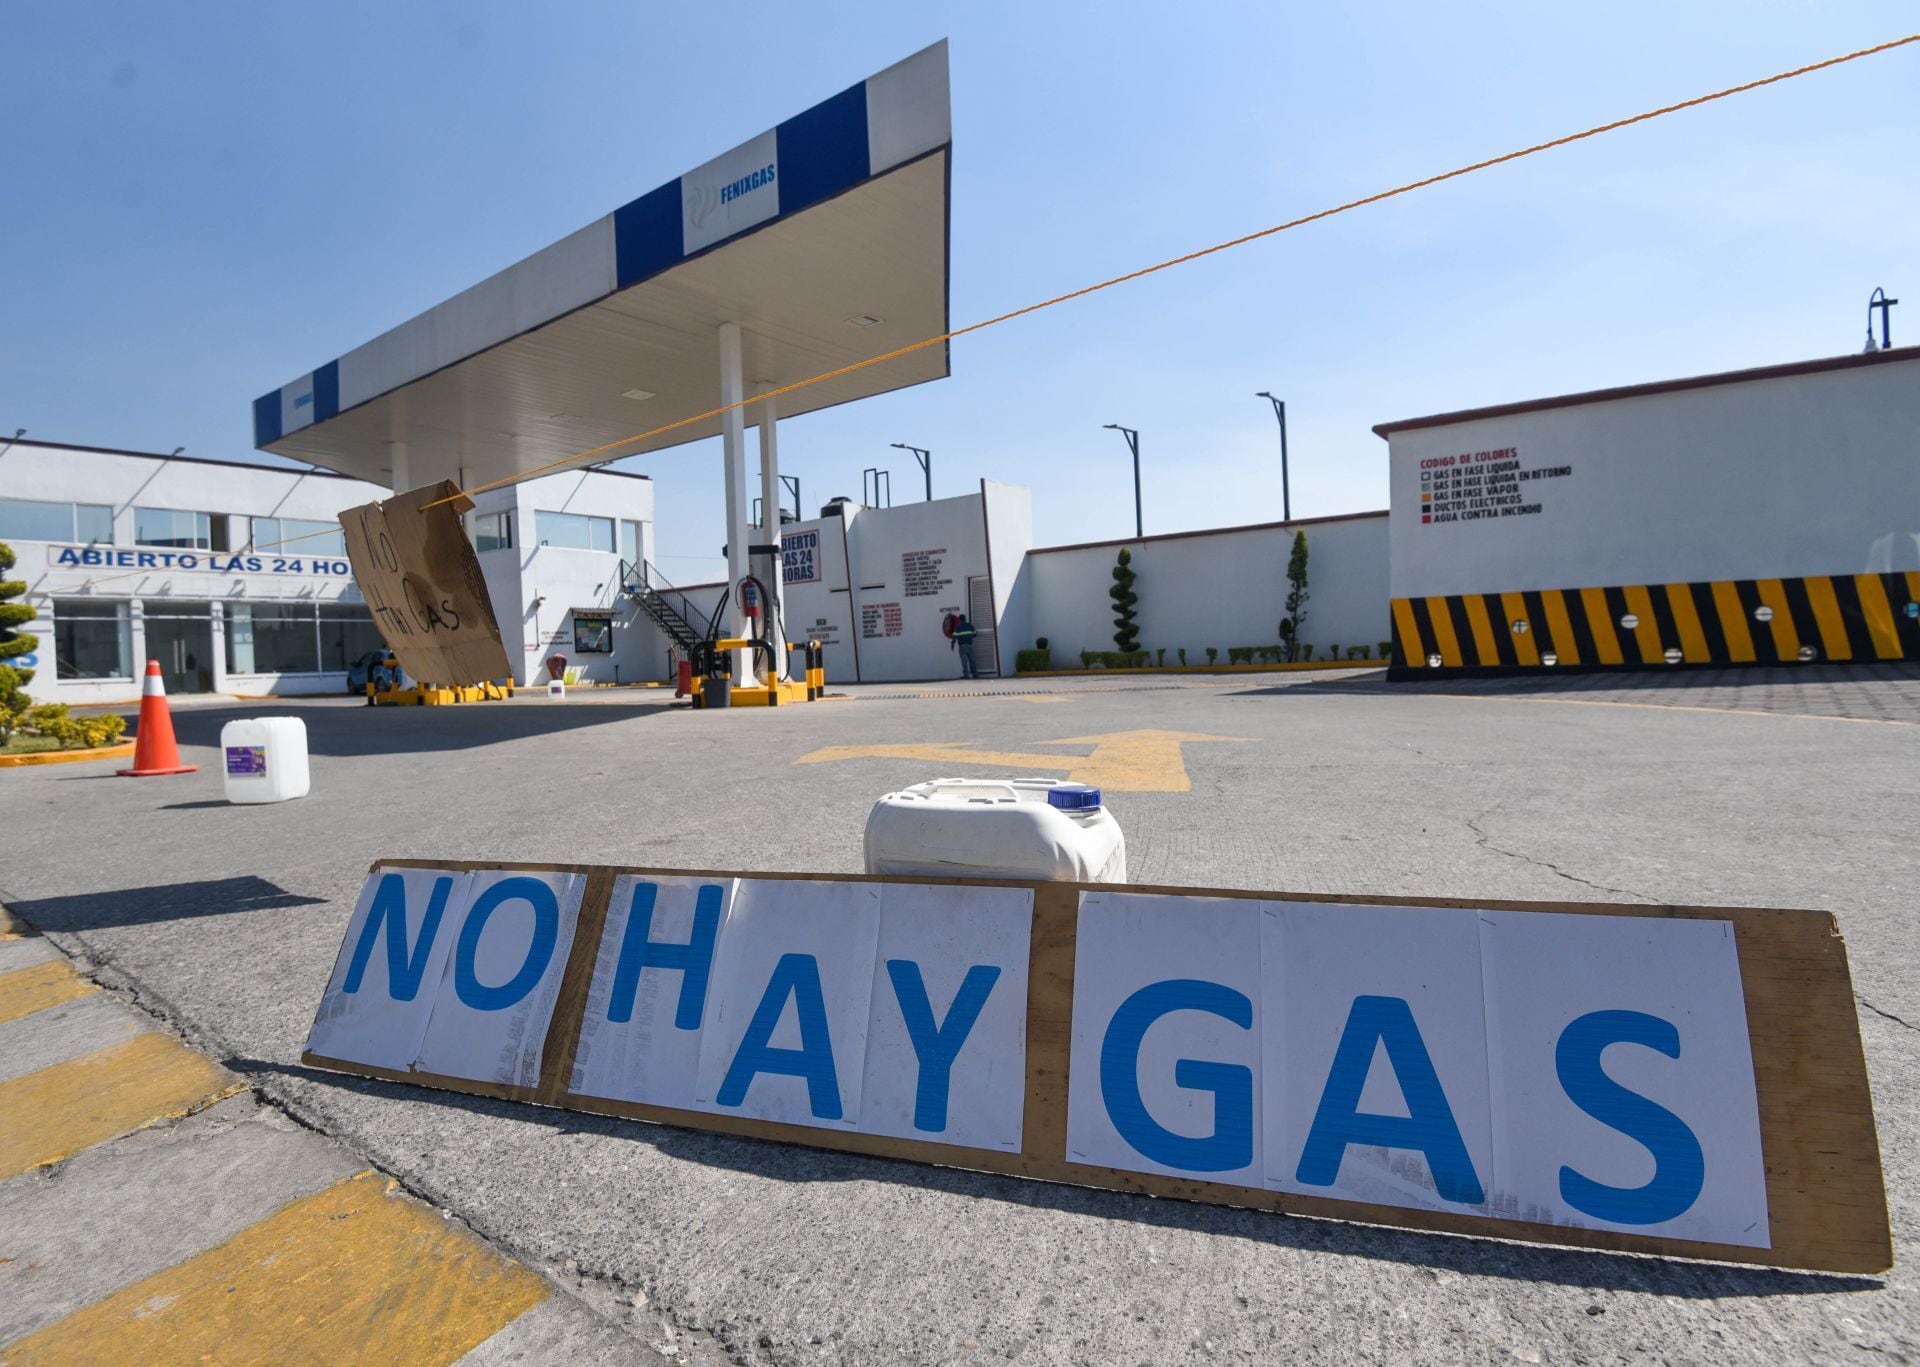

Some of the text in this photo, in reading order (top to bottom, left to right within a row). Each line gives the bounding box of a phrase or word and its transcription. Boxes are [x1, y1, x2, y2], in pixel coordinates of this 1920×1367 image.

[721, 164, 775, 205] FENIXGAS
[1420, 448, 1518, 469] CODIGO DE COLORES
[1433, 460, 1520, 479] GAS EN FASE LIQUIDA
[1433, 465, 1572, 490] GAS EN FASE LIQUIDA EN RETORNO
[1433, 483, 1519, 501] GAS EN FASE VAPOR
[1433, 503, 1542, 523] AGUA CONTRA INCENDIO
[1434, 494, 1522, 512] DUCTOS ELECTRICOS
[781, 533, 817, 552] BIERTO
[58, 548, 349, 575] ABIERTO LAS 24 HO
[782, 549, 813, 567] AS 24
[342, 874, 1706, 1226] NO HAY GAS
